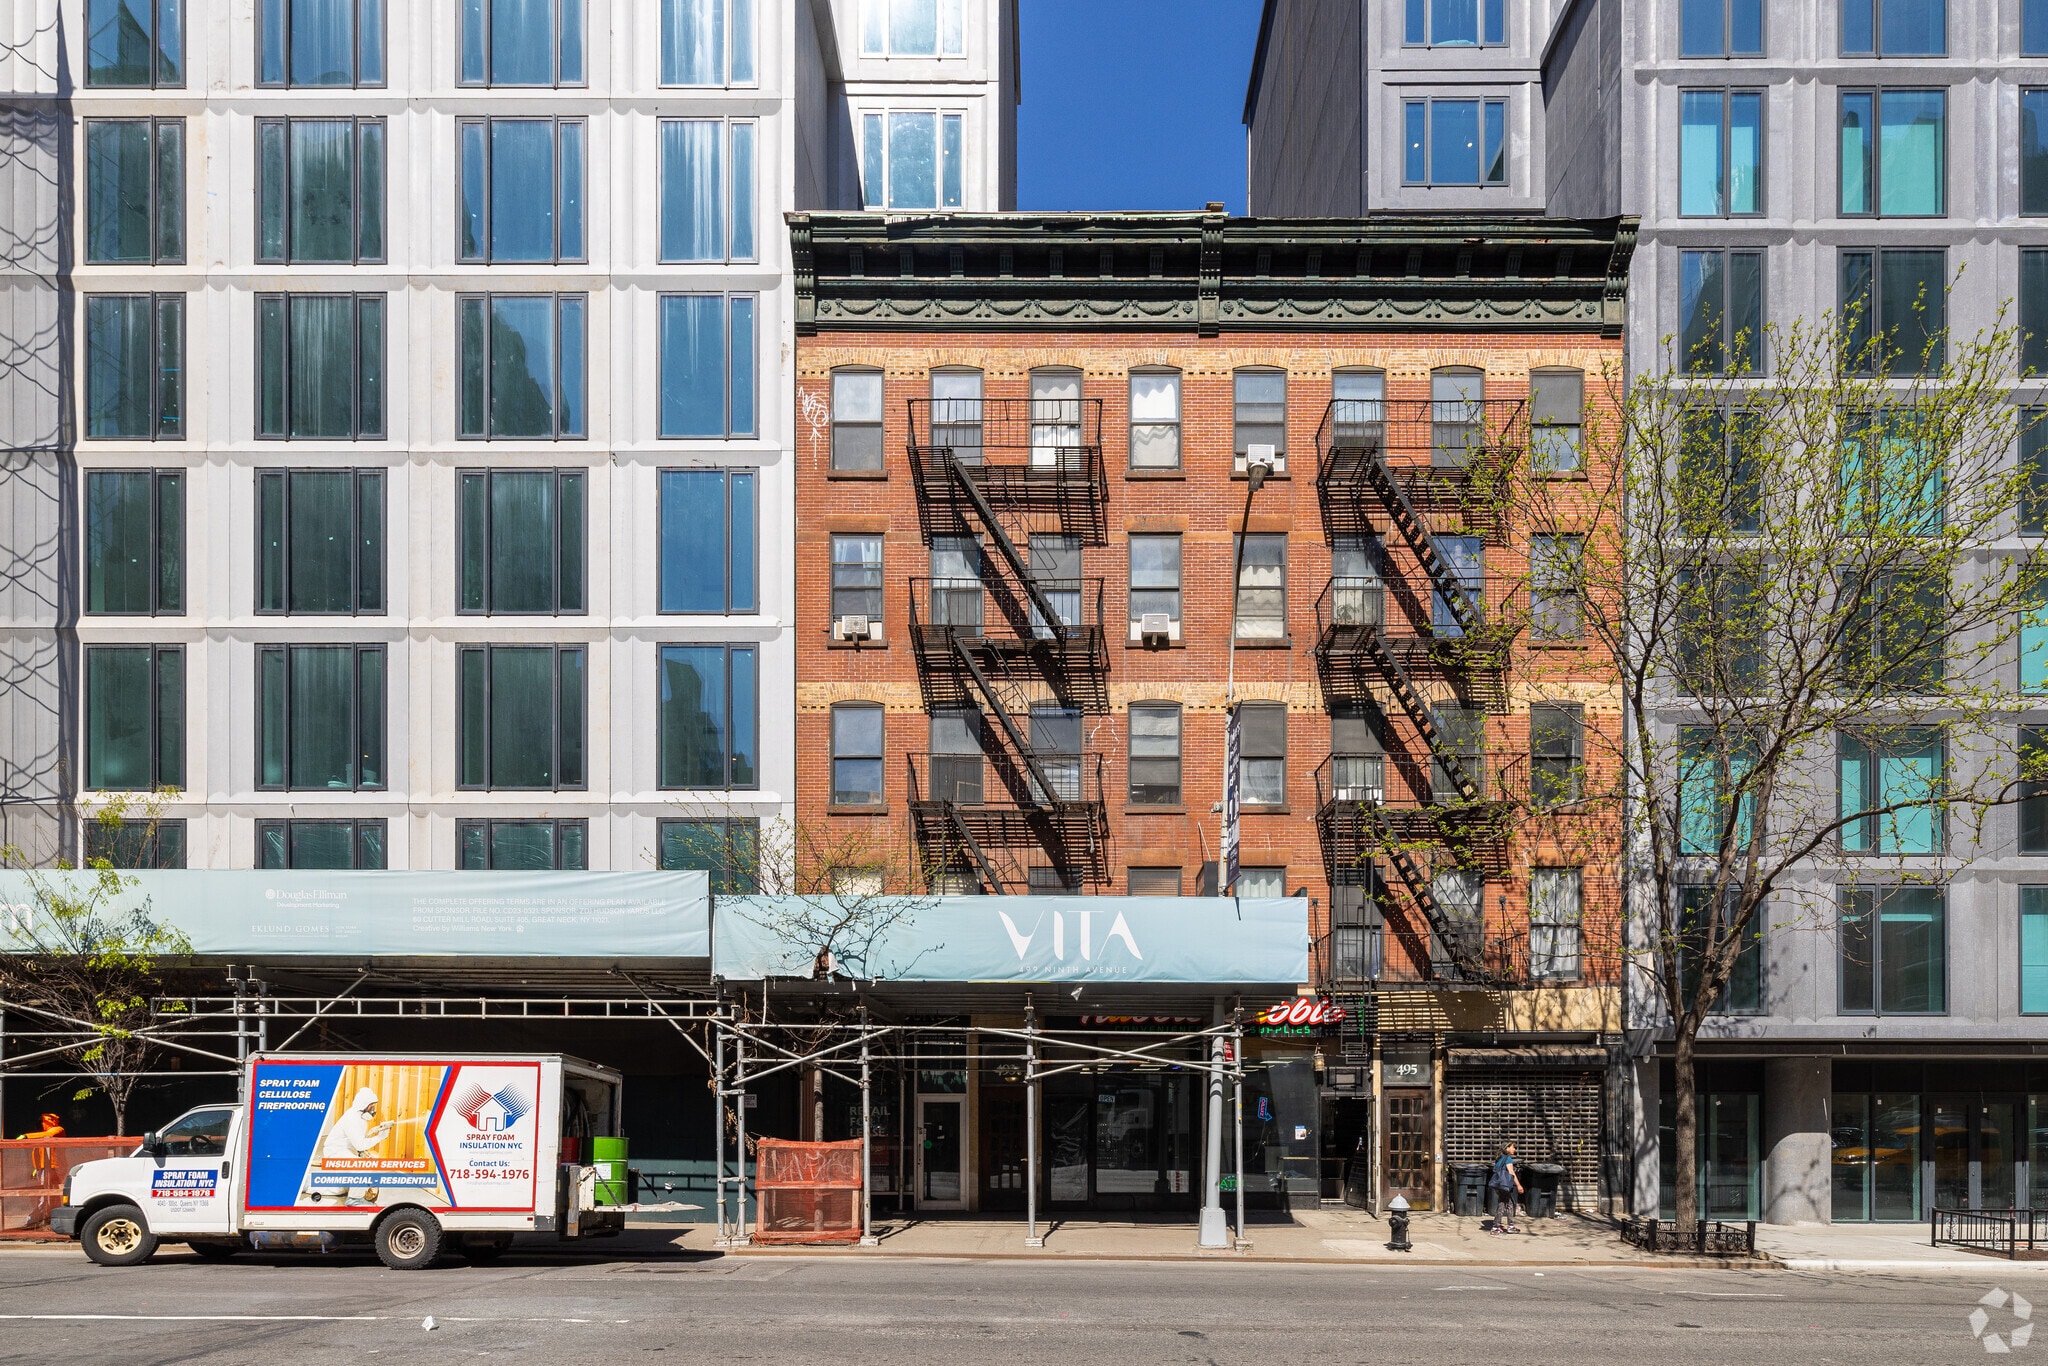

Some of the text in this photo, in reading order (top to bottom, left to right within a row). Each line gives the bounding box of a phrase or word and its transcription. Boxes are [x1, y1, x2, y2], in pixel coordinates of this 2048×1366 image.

[628, 898, 666, 906] AVAILABLE
[252, 925, 330, 933] EKLUND GOMES
[441, 925, 450, 933] by
[998, 910, 1143, 961] VITA
[1019, 966, 1127, 974] 499 NINTH AVENUE
[1396, 1063, 1418, 1076] 495
[259, 1079, 320, 1087] SPRAY FOAM
[259, 1091, 312, 1099] CELLULOSE
[258, 1102, 326, 1110] FIREPROOFING
[466, 1133, 515, 1141] SPRAY FOAM
[325, 1160, 426, 1169] INSULATION SERVICES
[162, 1171, 209, 1179] SPRAY FOAM
[450, 1169, 530, 1179] 718-594-1976
[154, 1179, 214, 1187] INSULATION NYC
[314, 1176, 372, 1185] COMMERCIAL
[380, 1176, 437, 1185] RESIDENTIAL
